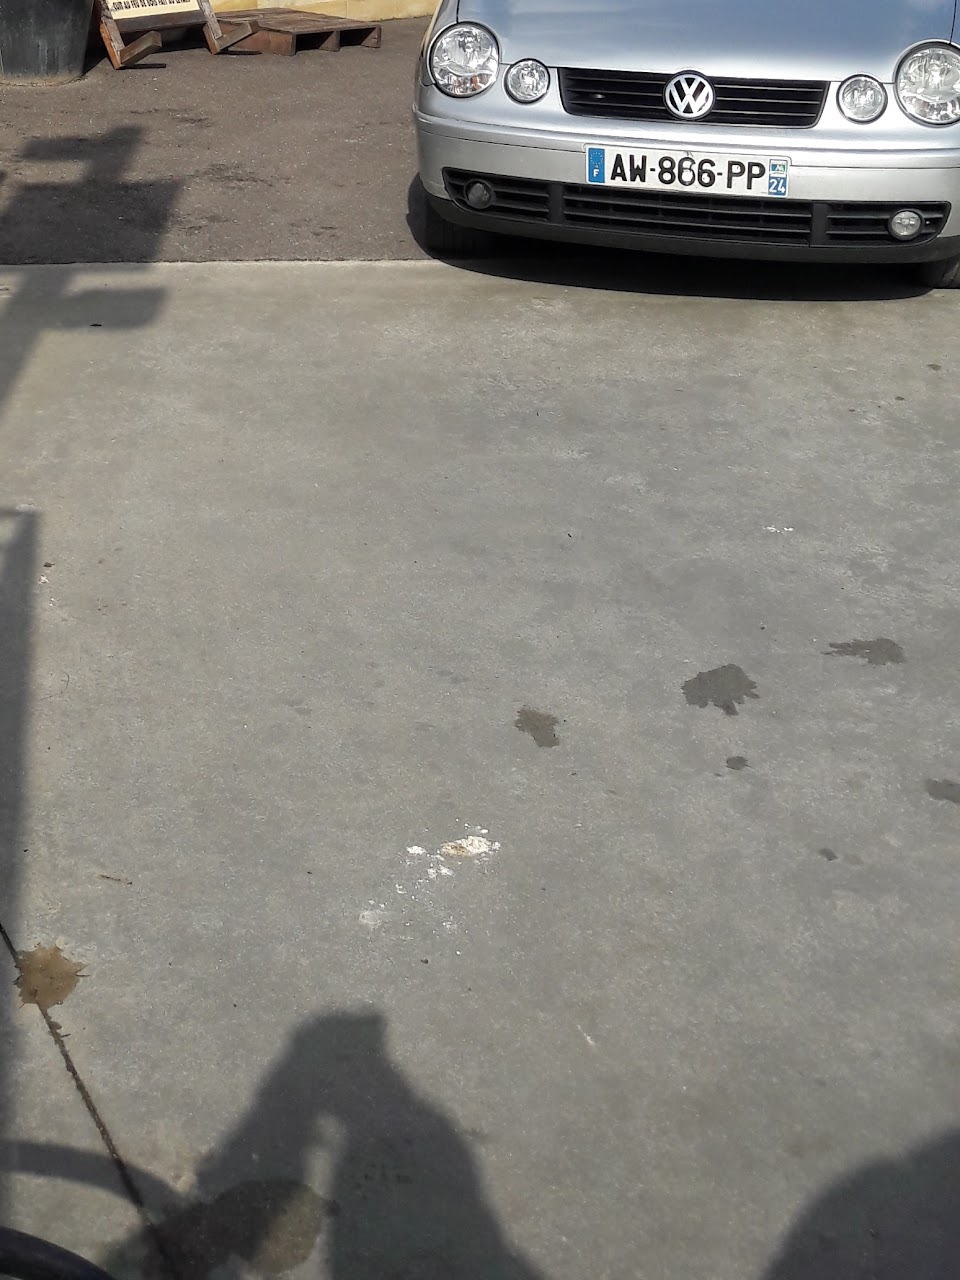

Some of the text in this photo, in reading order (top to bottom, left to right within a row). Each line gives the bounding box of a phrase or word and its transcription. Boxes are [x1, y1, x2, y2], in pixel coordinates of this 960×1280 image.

[123, 1, 132, 10] AU
[131, 0, 140, 9] FEU
[139, 0, 147, 8] DE
[592, 168, 600, 178] F
[610, 153, 767, 190] AW-866-PP
[768, 177, 786, 194] 24
